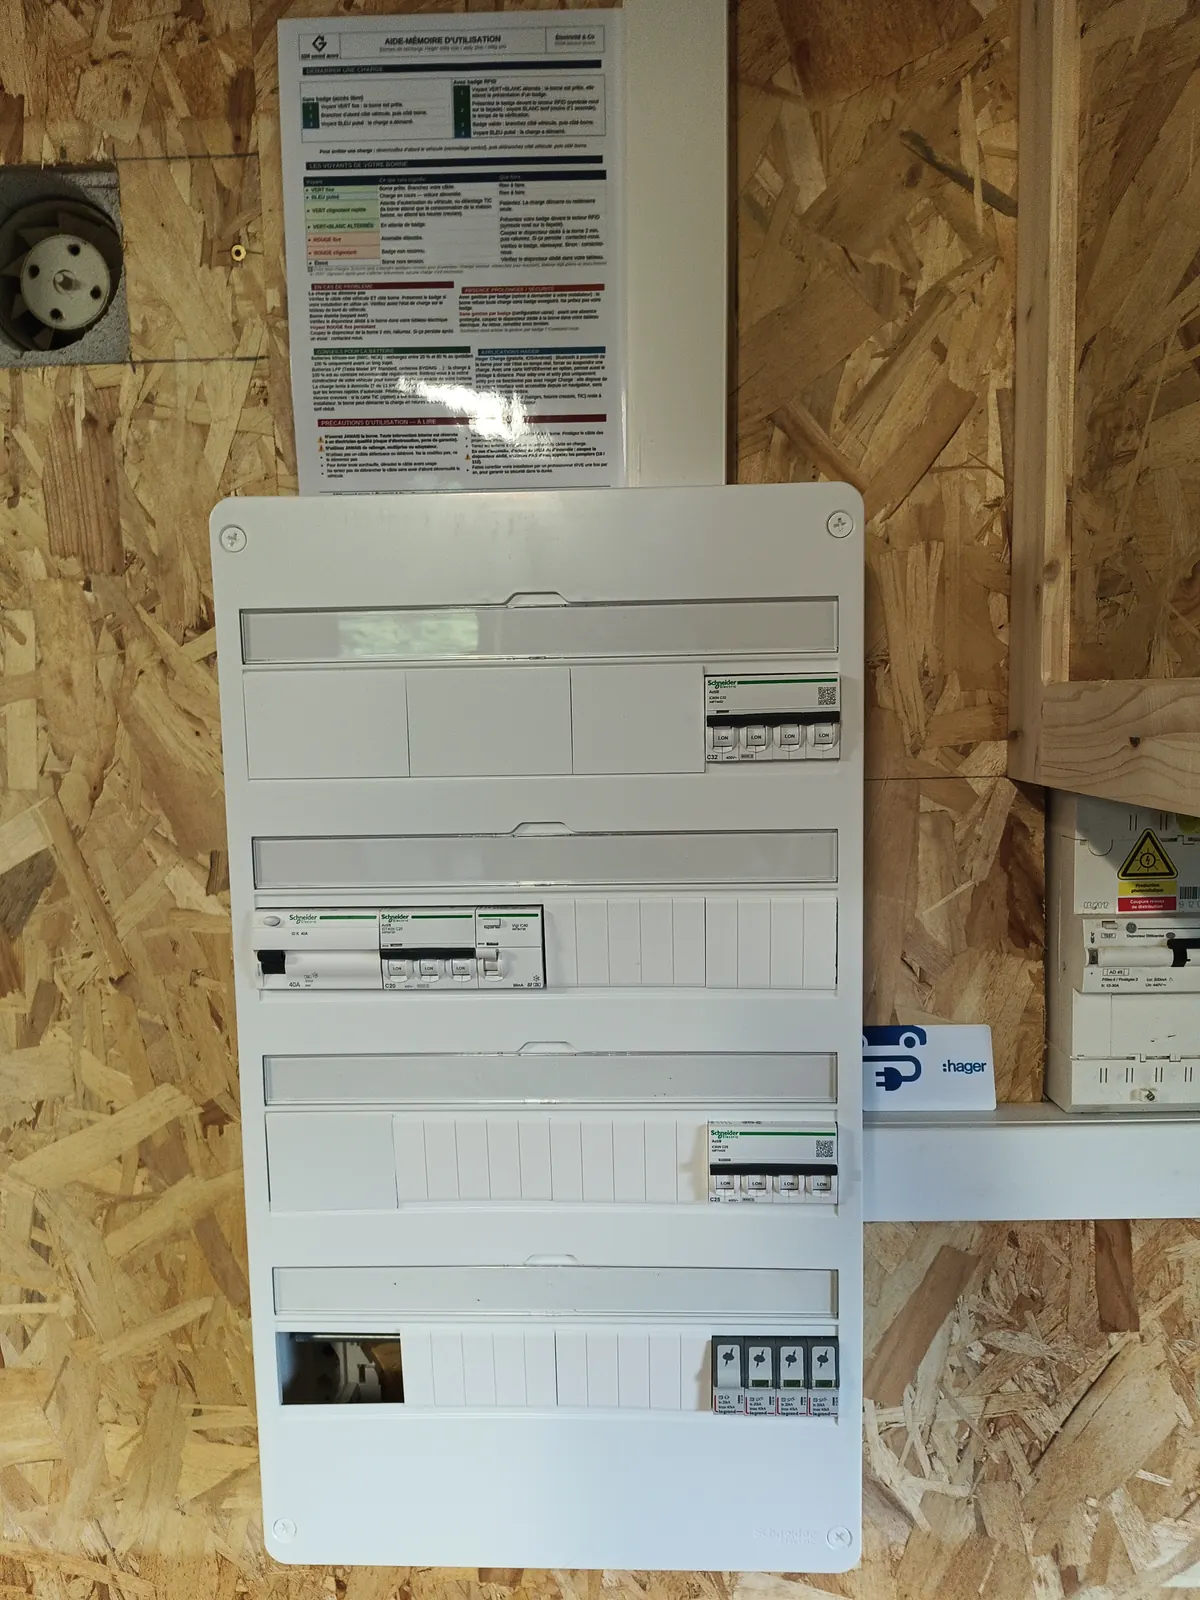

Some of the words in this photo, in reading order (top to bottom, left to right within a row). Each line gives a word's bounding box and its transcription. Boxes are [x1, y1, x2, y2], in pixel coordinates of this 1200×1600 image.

[384, 36, 442, 45] AIDE-MÉMOIRE
[444, 35, 501, 44] D'UTILISATION
[321, 419, 364, 427] PRÉCAUTIONS
[708, 679, 737, 690] Schneider
[289, 914, 318, 925] Schneider
[381, 914, 410, 923] Schneider
[711, 1129, 739, 1139] Schneider
